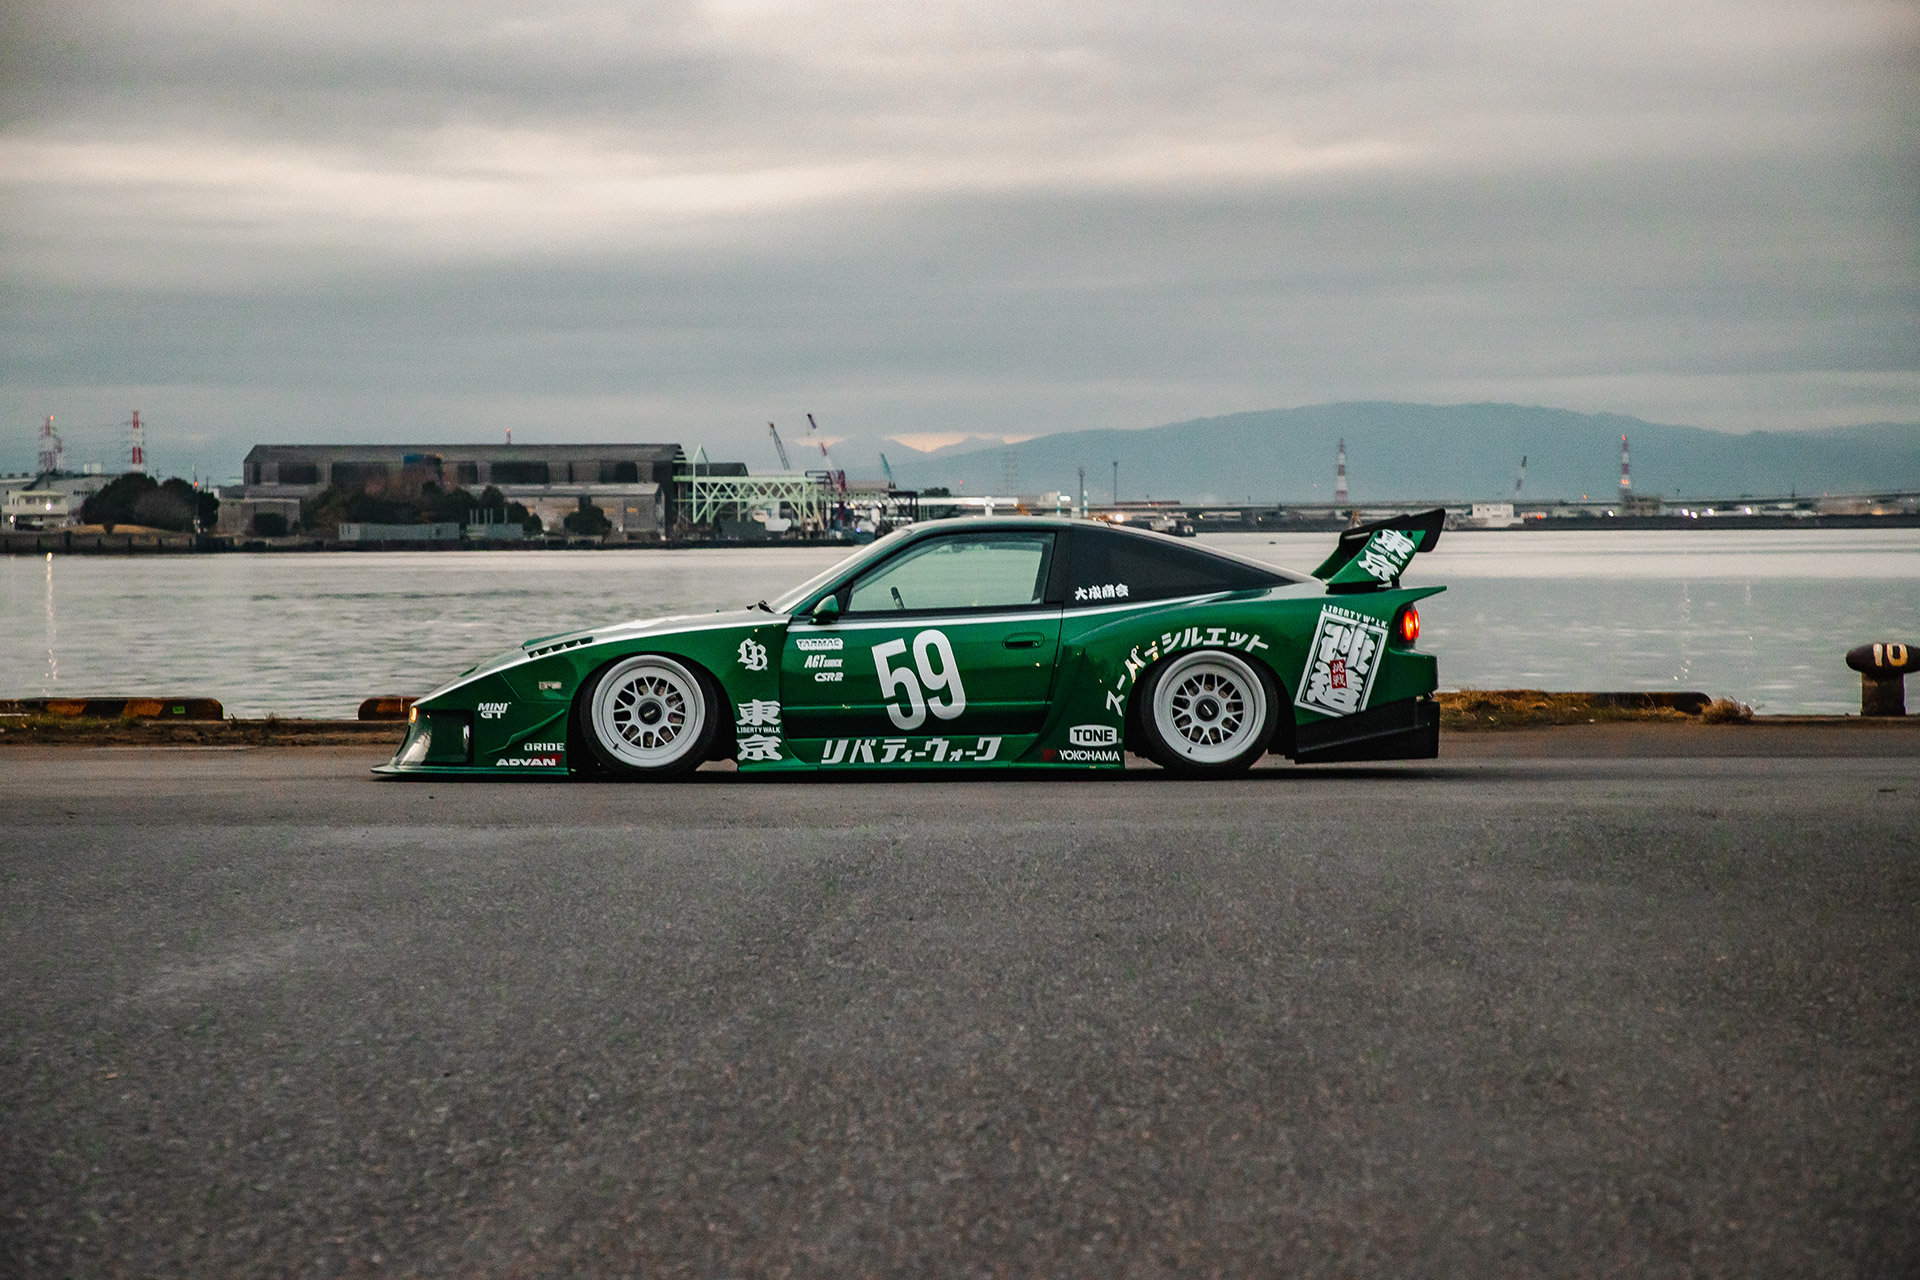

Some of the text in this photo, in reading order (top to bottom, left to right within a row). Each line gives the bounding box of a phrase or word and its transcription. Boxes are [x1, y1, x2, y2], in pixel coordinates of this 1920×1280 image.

[1321, 603, 1362, 622] LIBERTY
[1873, 643, 1908, 667] 10
[871, 629, 967, 731] 59
[478, 702, 508, 712] MINI
[480, 711, 503, 719] GT
[736, 726, 781, 734] LIBERTY WALK
[1073, 728, 1114, 742] TONE
[524, 742, 565, 752] BRIDE
[821, 737, 1002, 764] リバティーウォーク
[1059, 749, 1120, 762] YOKOHAMA
[496, 758, 556, 767] ADVAN
